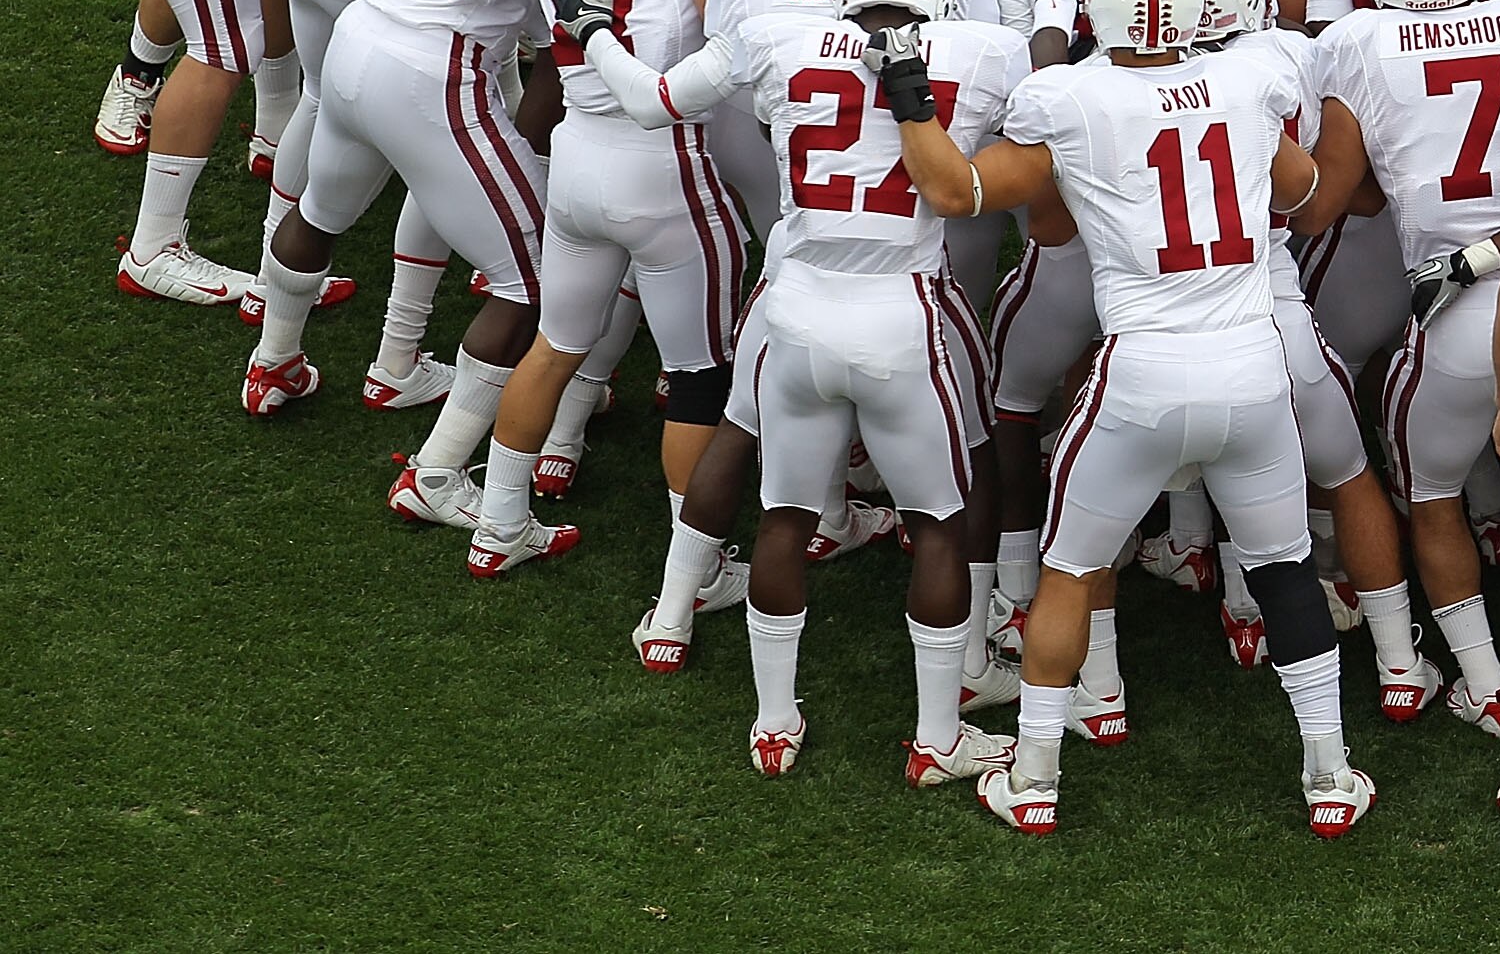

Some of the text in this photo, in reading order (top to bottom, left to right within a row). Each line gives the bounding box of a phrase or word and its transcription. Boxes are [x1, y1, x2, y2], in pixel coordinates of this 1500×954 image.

[1165, 28, 1176, 42] 11
[1157, 79, 1212, 112] SKOV
[789, 68, 959, 218] 27
[1147, 123, 1254, 274] 11
[538, 459, 571, 478] NIKE
[646, 644, 682, 664] NIKE
[1384, 690, 1415, 707] NIKE
[1098, 717, 1128, 736] NIKE
[1023, 806, 1056, 826] NIKE
[1312, 806, 1346, 825] NIKE
